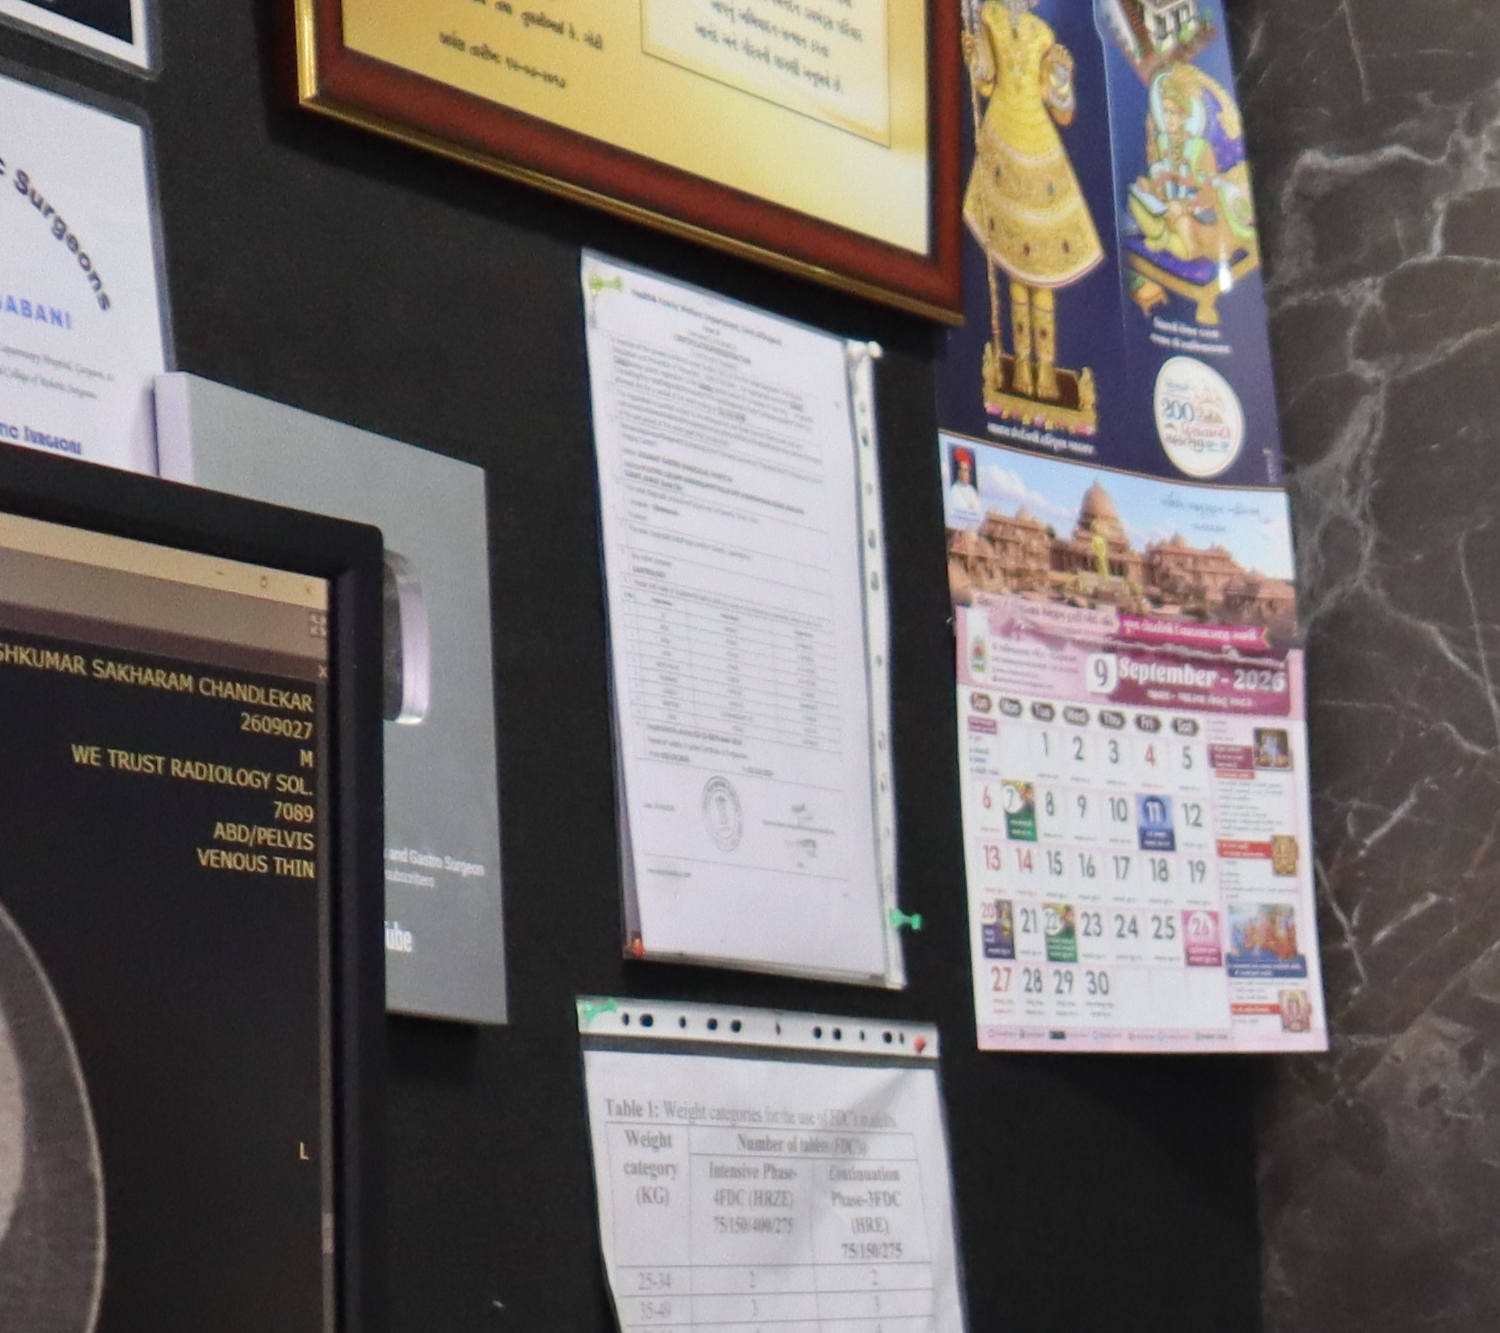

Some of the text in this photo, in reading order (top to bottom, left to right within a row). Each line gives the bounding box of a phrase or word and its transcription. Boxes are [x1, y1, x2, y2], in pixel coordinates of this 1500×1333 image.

[14, 169, 111, 311] Surgeons
[0, 294, 72, 330] ABANI
[92, 659, 193, 692] SAKHARAM
[200, 677, 314, 712] CHANDLEKAR
[1094, 657, 1109, 687] 9
[1117, 657, 1218, 688] September
[1232, 668, 1286, 692] 2026
[240, 712, 314, 740] 2609027
[300, 748, 314, 768] M
[1042, 732, 1192, 770] 1 2 3 4 5
[71, 744, 314, 796] WE TRUST RADIOLOGY SOL.
[273, 801, 314, 823] 7089
[983, 785, 1203, 828] 6 7 8 9 10 11 12
[213, 821, 315, 851] ABD/PELVIS
[197, 848, 315, 879] VENOUS THIN
[389, 848, 408, 863] and
[444, 855, 486, 877] Surgeon
[983, 845, 1001, 871] 13
[1016, 848, 1034, 874] 14
[1047, 851, 1063, 876] 15
[1079, 853, 1096, 878] 16
[1113, 856, 1131, 880] 17
[1150, 857, 1169, 882] 18
[1187, 859, 1206, 884] 19
[981, 902, 1210, 940] 20 21 22 23 24 25 26
[384, 921, 413, 952] ube
[991, 966, 1110, 995] 27 28 29 30
[604, 1099, 643, 1118] Table
[663, 1100, 706, 1124] Weight
[299, 1142, 310, 1160] L
[624, 1129, 672, 1153] Weight
[738, 1133, 784, 1151] Number
[623, 1160, 677, 1181] category
[709, 1161, 759, 1179] Intensive
[829, 1165, 900, 1181] Continuation
[636, 1186, 670, 1208] (KG)
[851, 1216, 889, 1234] (HRE)
